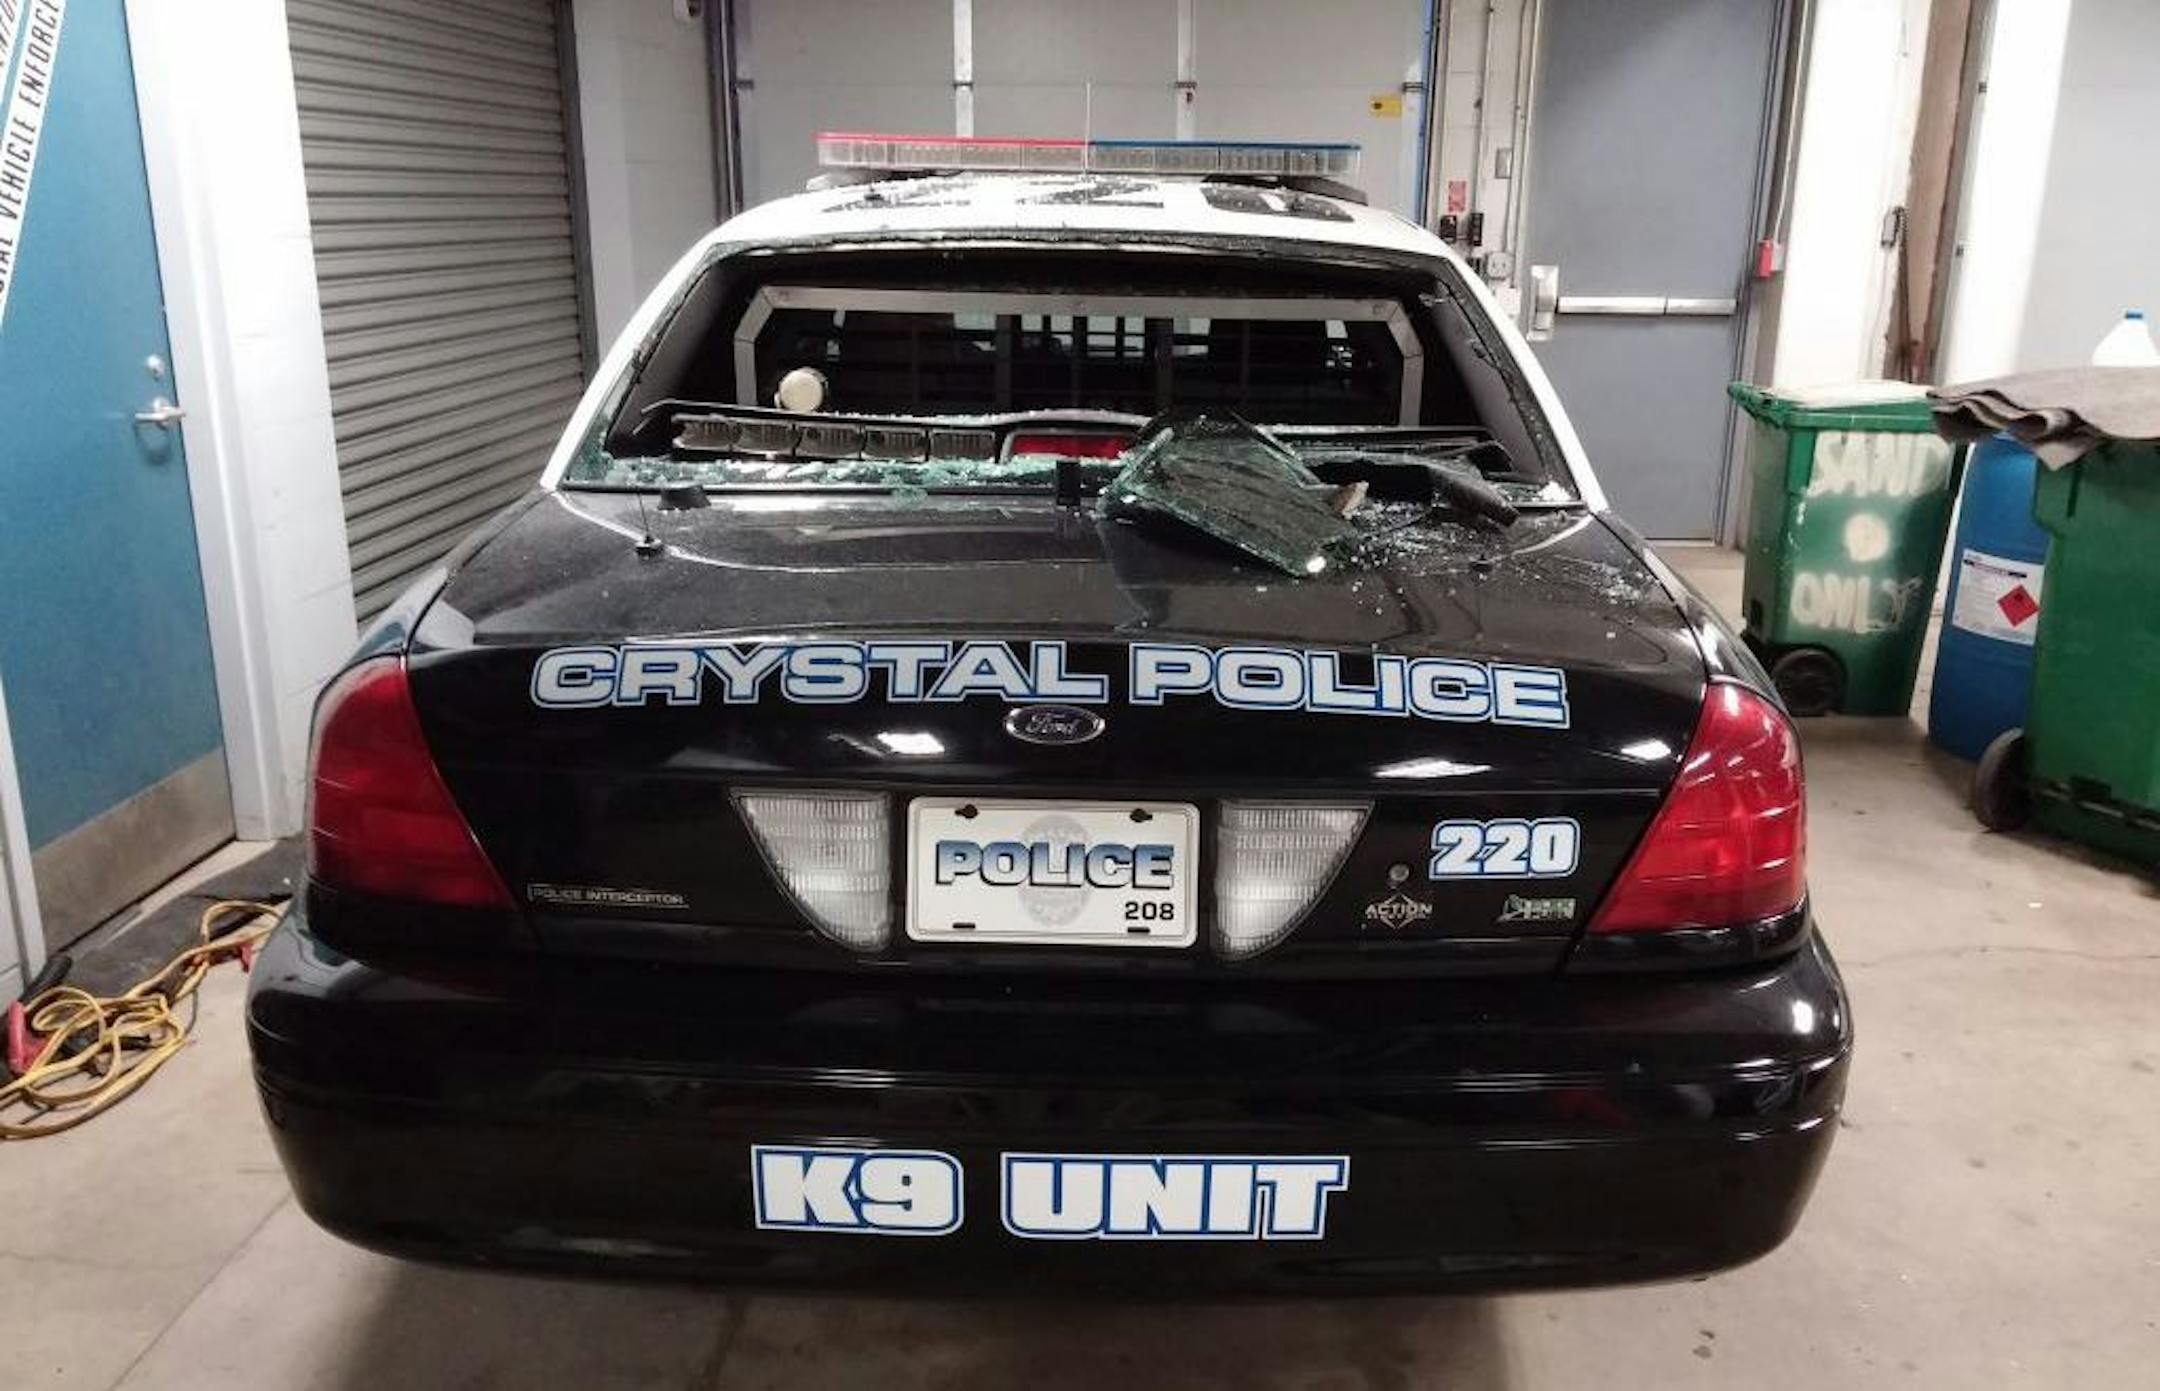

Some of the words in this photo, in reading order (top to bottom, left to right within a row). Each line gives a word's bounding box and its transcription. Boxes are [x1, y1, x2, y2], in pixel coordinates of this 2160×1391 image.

[0, 118, 36, 218] VEHICLE
[531, 640, 1109, 708] CRYSTAL
[1128, 642, 1570, 728] POLICE
[1025, 712, 1082, 735] Ford
[935, 840, 1174, 890] POLICE
[1429, 816, 1581, 880] 220
[533, 886, 582, 900] POLICE
[586, 889, 685, 905] INTERCEPTOR
[1125, 901, 1174, 921] 208
[1364, 903, 1433, 918] ACTION
[751, 1145, 963, 1236] K9
[1001, 1152, 1350, 1240] UNIT
